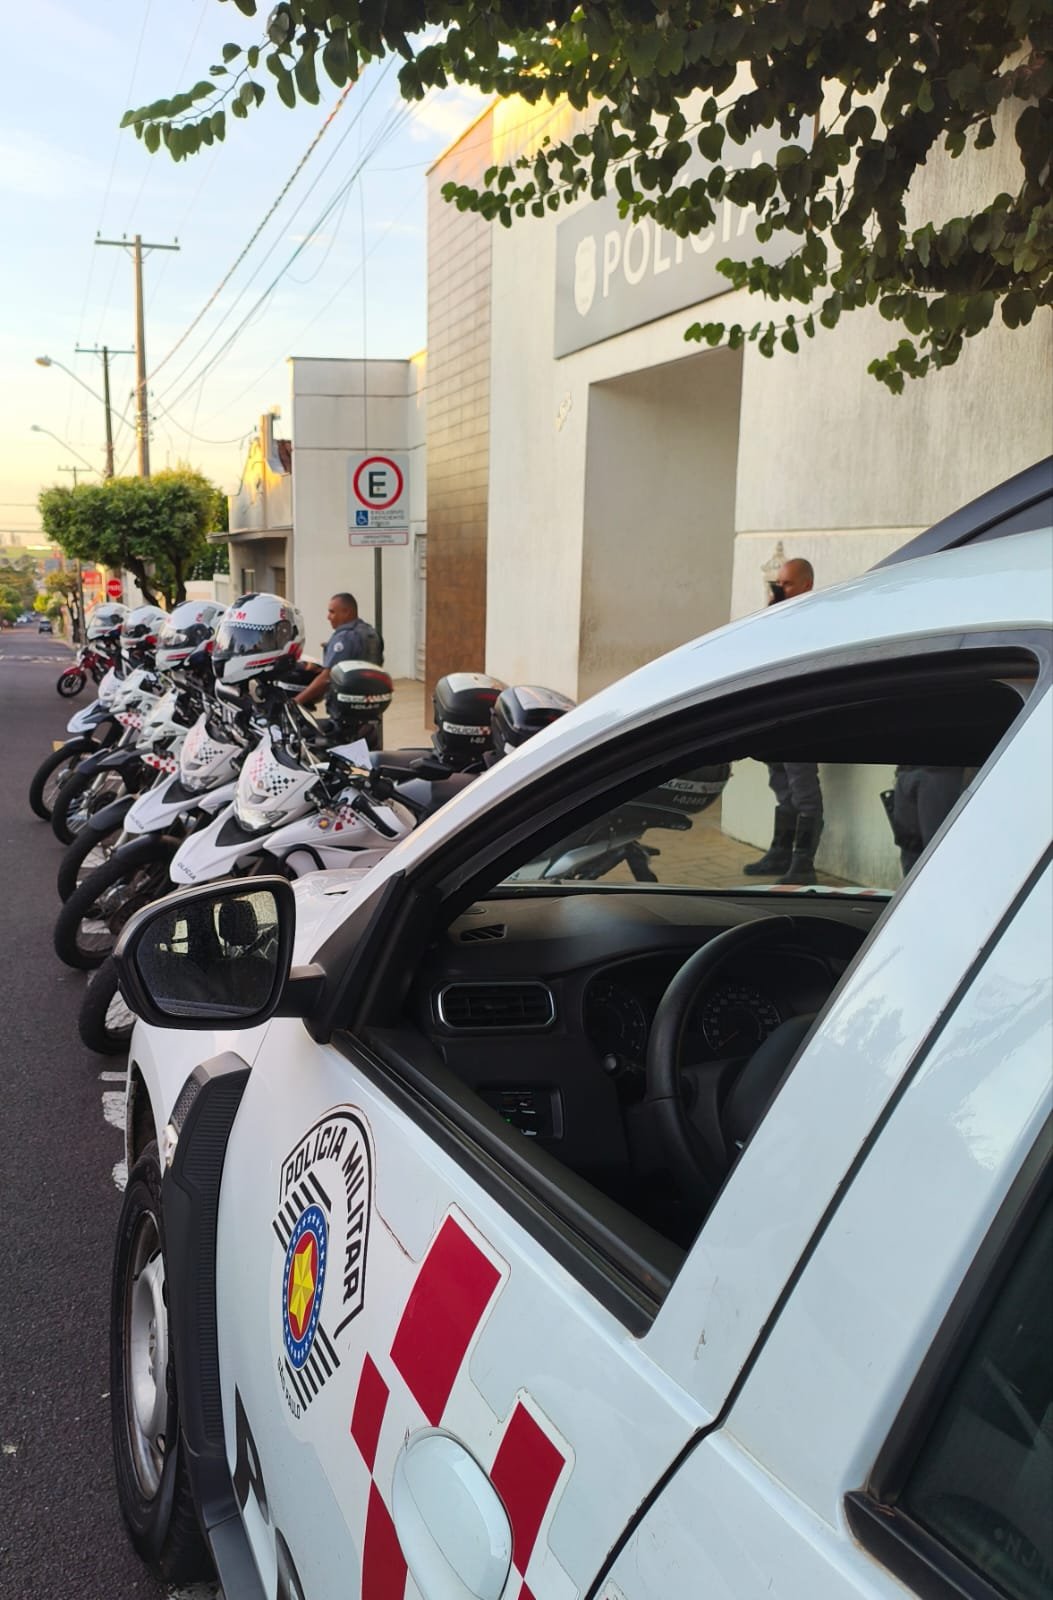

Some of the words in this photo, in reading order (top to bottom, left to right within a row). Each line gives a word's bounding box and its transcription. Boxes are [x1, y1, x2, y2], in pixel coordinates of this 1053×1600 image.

[368, 471, 387, 498] E
[284, 1126, 348, 1196] POLÍCIA
[341, 1139, 365, 1305] MILITAR
